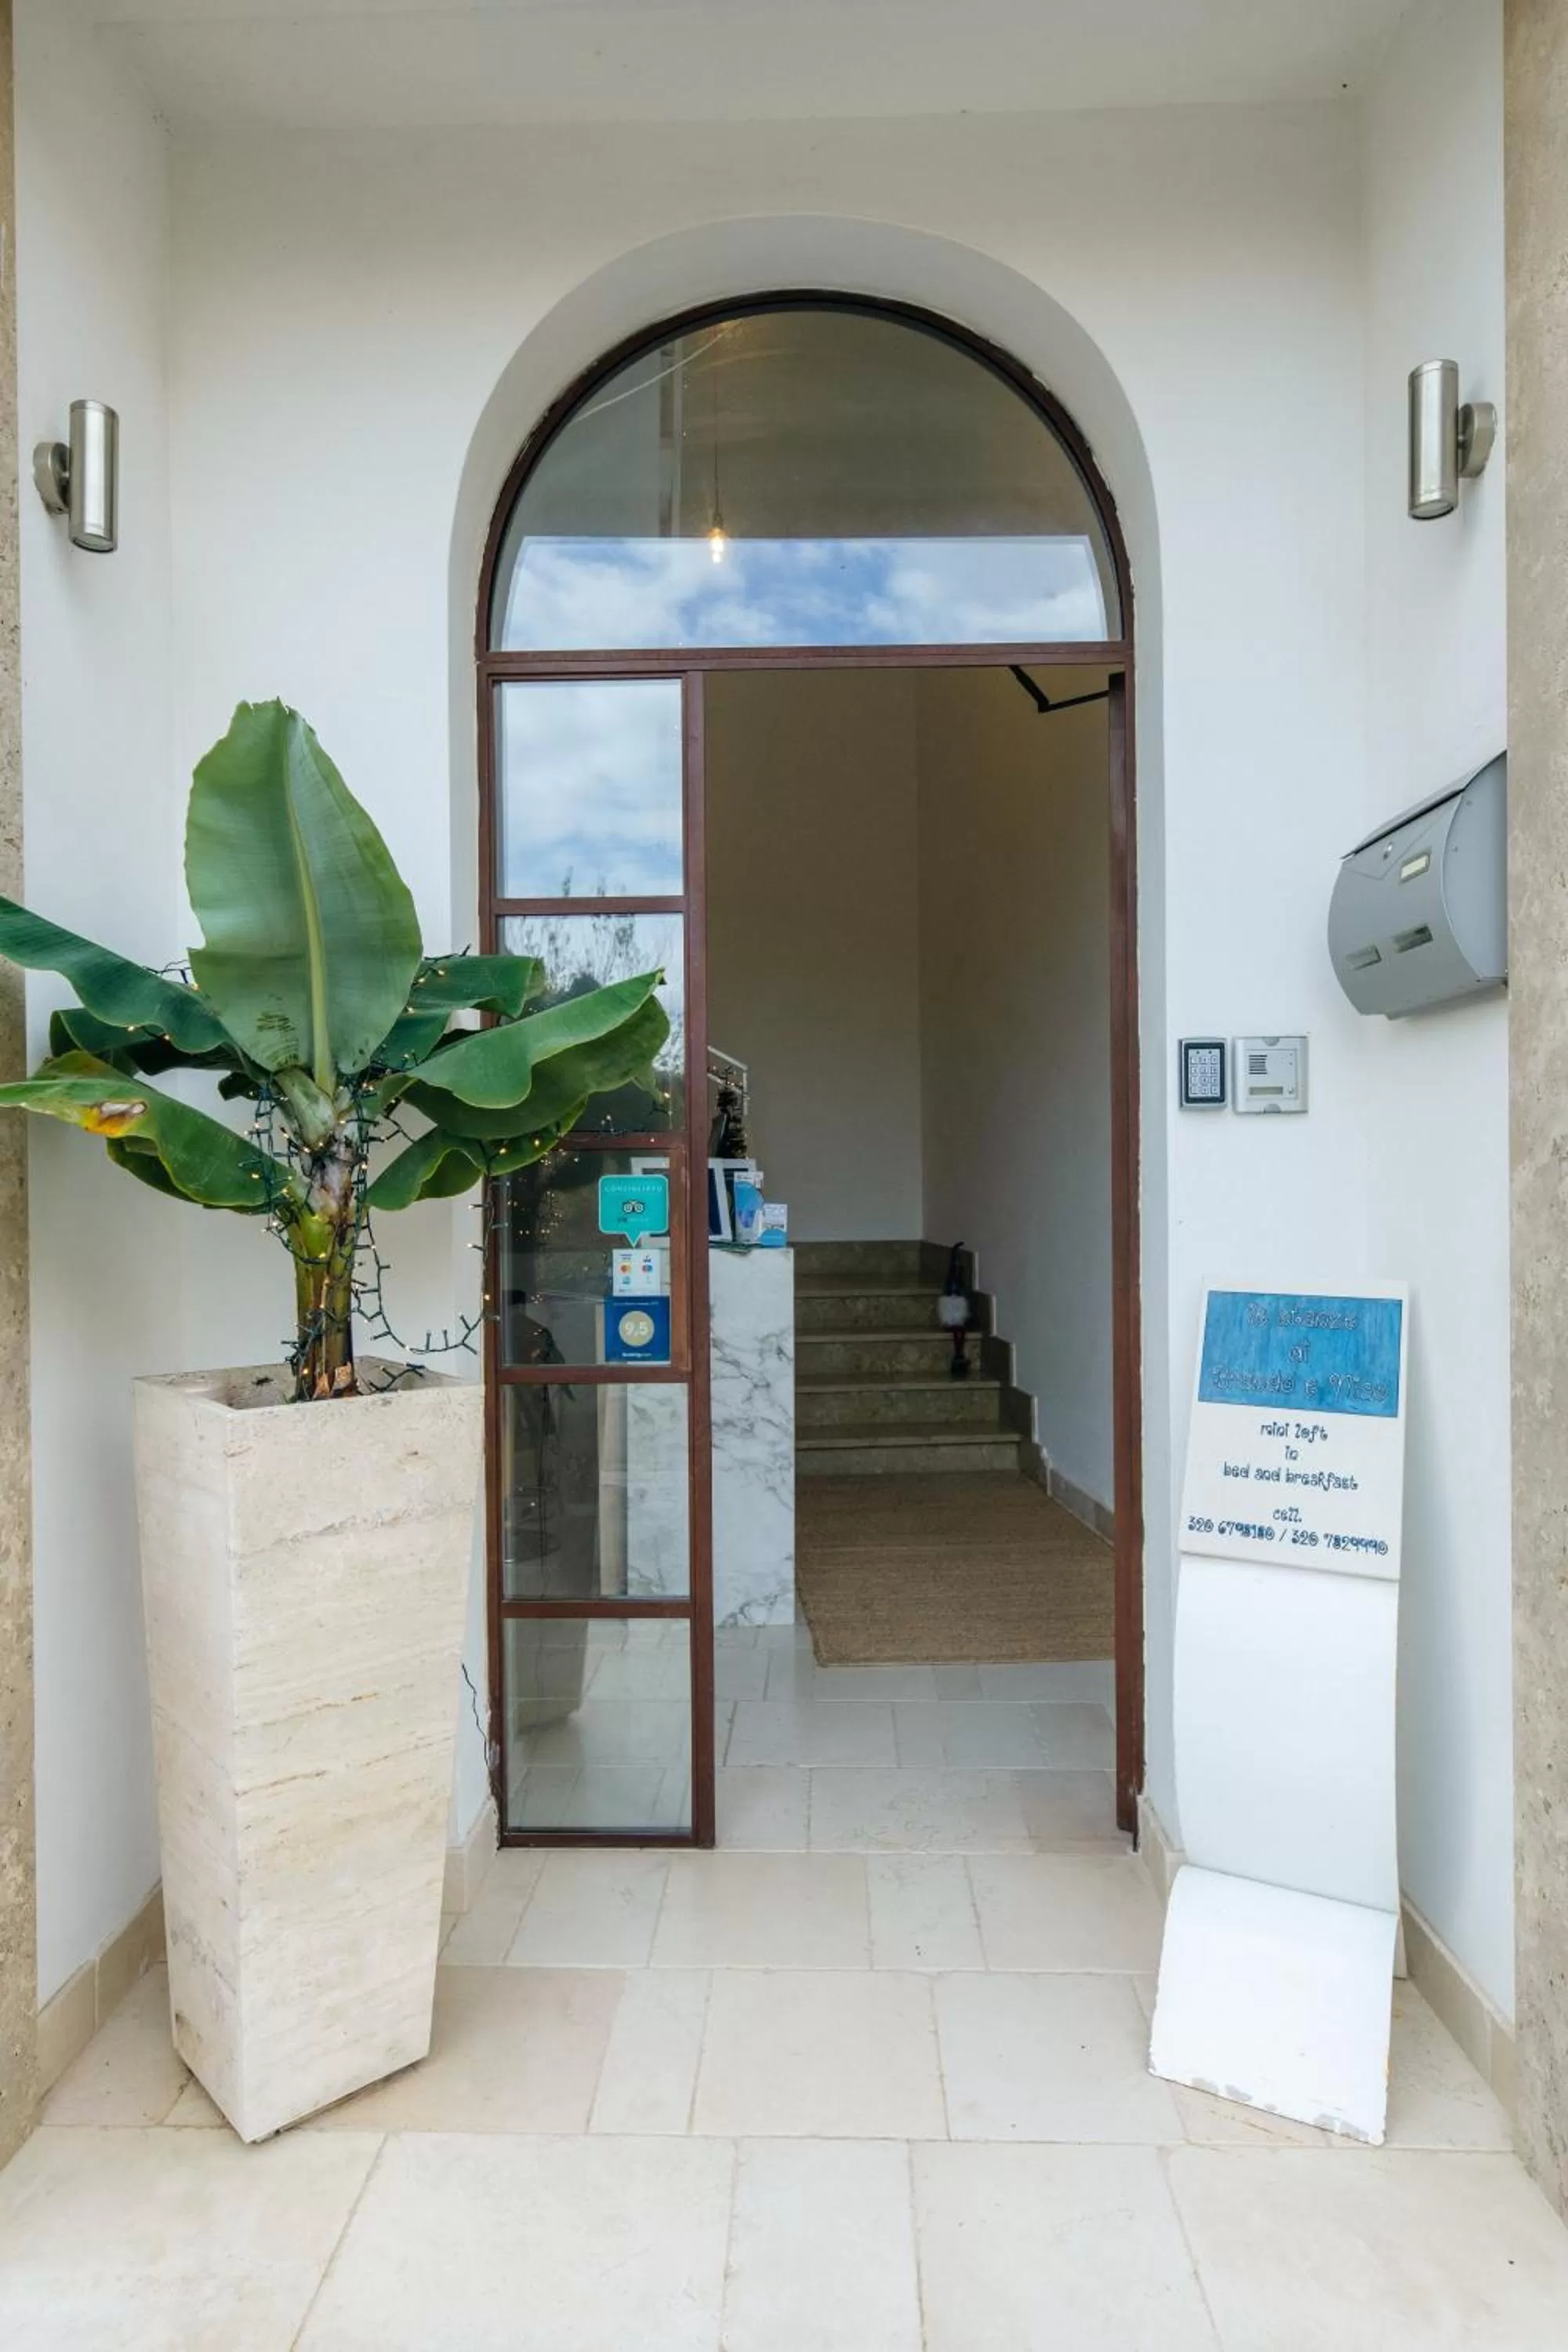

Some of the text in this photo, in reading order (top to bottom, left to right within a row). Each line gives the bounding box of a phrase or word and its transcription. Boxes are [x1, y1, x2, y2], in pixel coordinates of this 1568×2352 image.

[1260, 1421, 1328, 1443] mini loft
[1285, 1445, 1299, 1461] in
[1223, 1461, 1358, 1491] bed and breakfast
